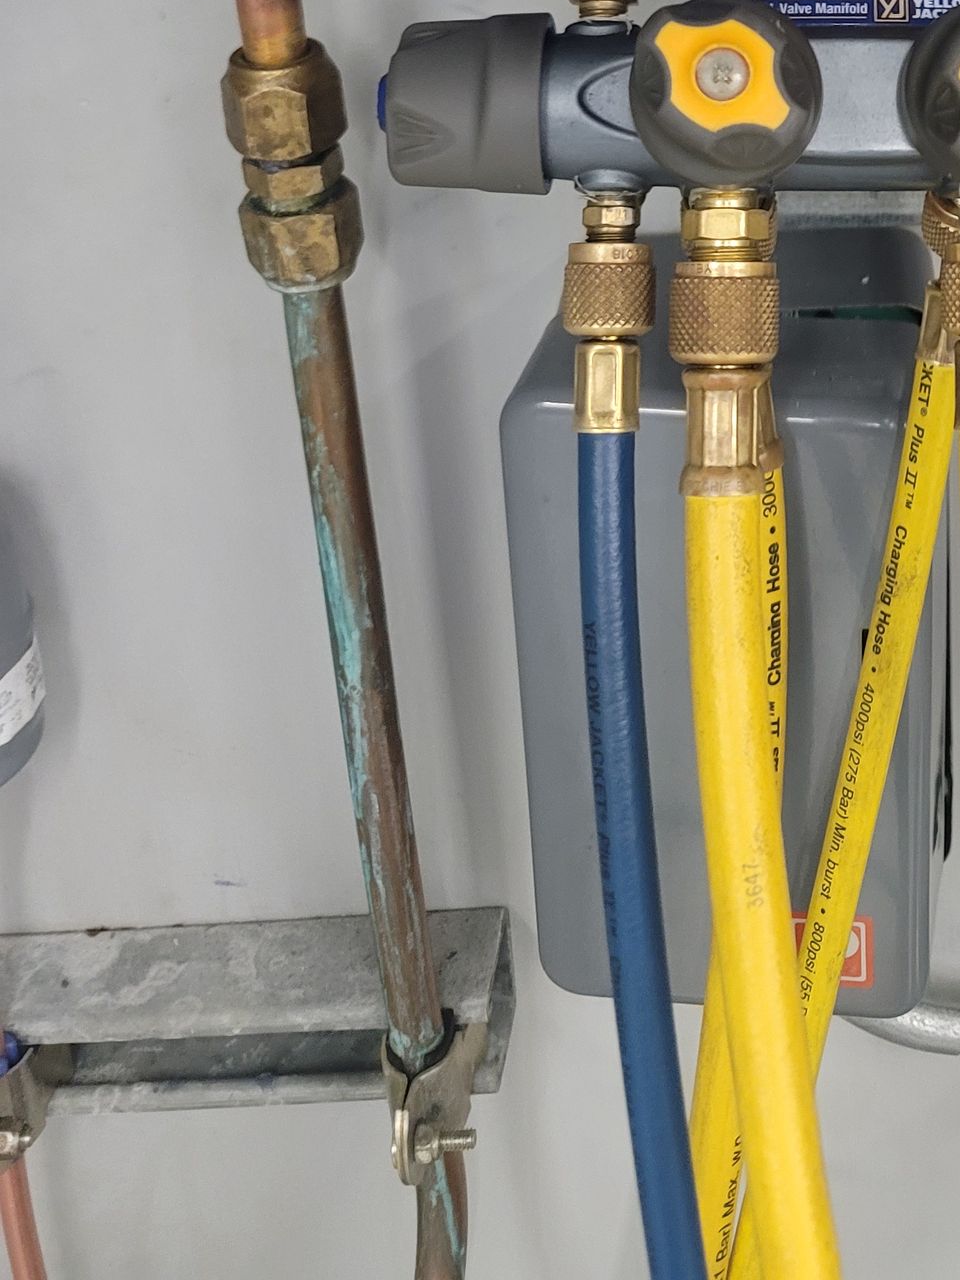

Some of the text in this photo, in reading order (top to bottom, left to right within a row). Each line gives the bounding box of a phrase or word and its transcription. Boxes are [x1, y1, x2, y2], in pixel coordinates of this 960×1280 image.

[780, 2, 868, 14] Valve Manifold
[908, 424, 924, 464] Plus
[767, 542, 780, 594] Hose
[880, 524, 908, 606] Charging
[872, 610, 891, 655] Hose
[583, 622, 600, 712] YELLOW
[853, 682, 875, 747] 4000psi
[845, 746, 862, 784] (275
[838, 787, 855, 820] Bar)
[829, 822, 847, 854] Min.
[822, 862, 839, 900] burst
[805, 921, 825, 976] 800psi
